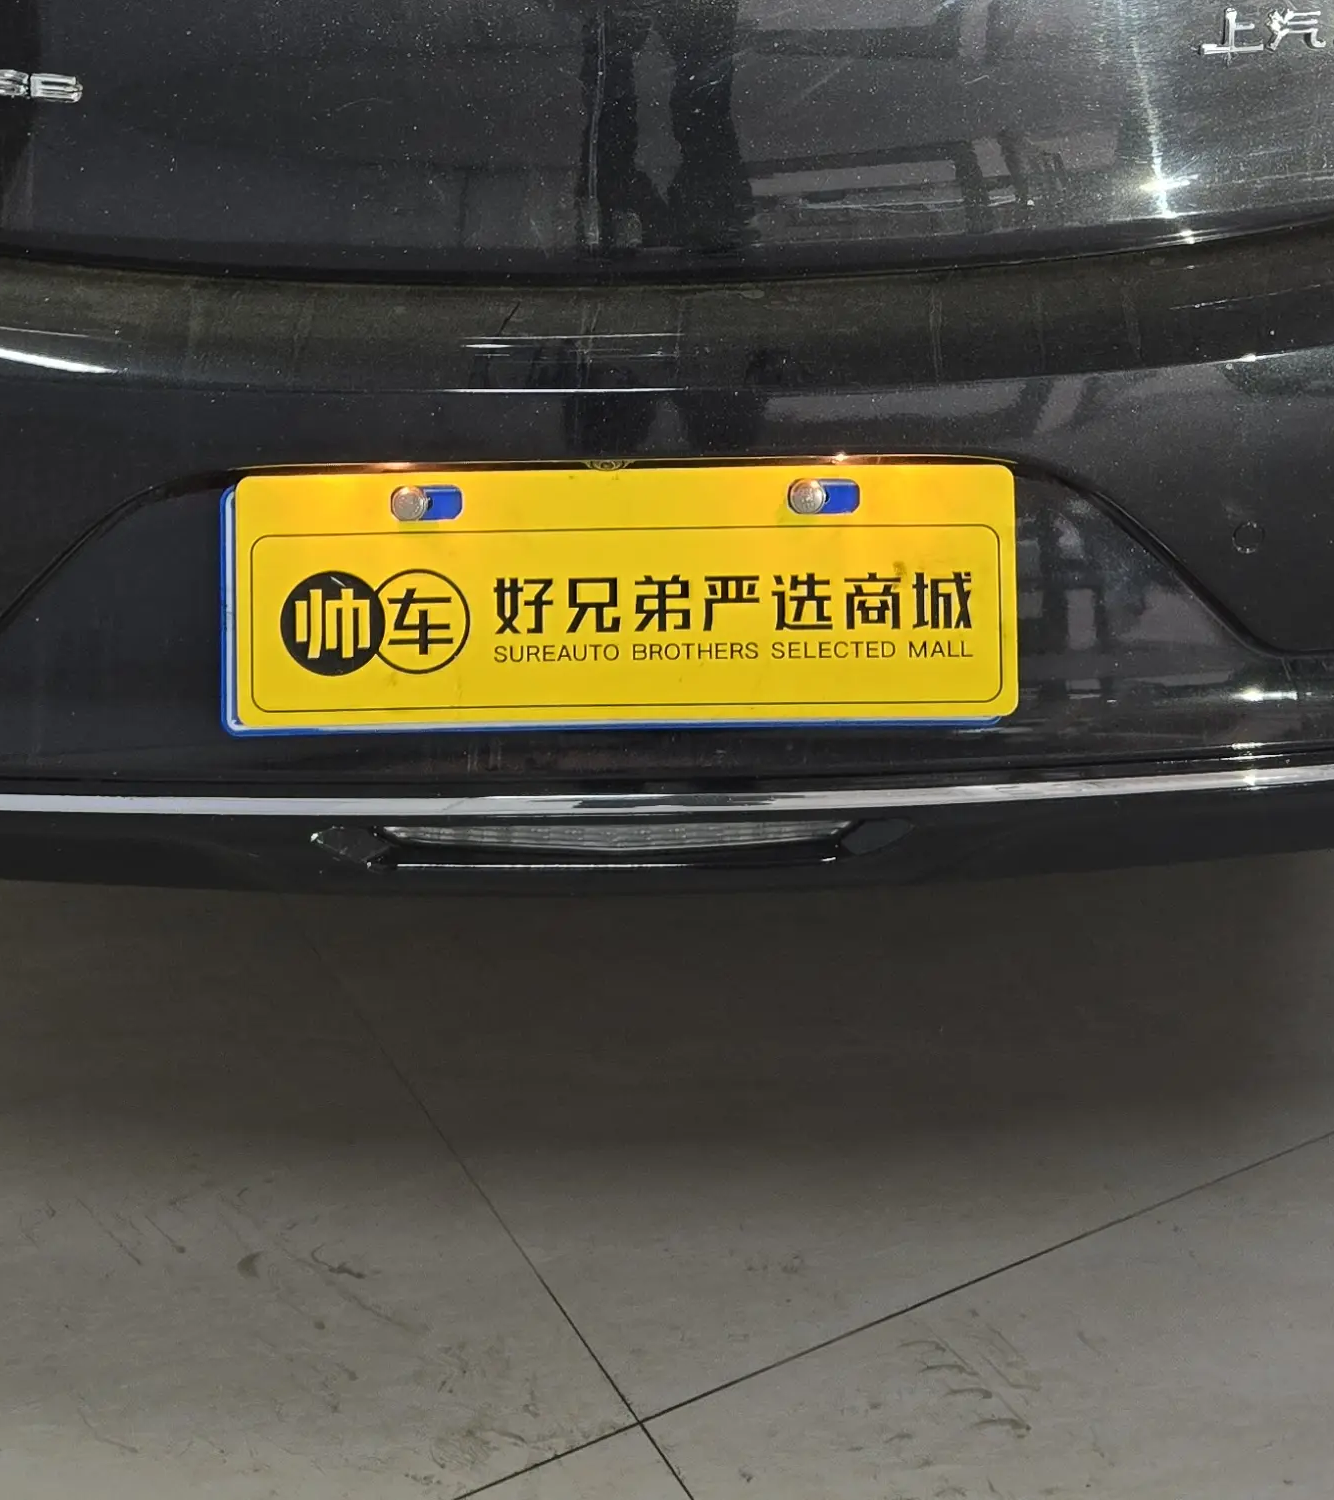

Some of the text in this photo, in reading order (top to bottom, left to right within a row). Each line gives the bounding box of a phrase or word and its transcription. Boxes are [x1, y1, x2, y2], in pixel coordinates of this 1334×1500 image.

[493, 571, 973, 635] 好兄弟严选商城
[493, 639, 974, 663] SUREAUTO BROTHERS SELECTED MALL
